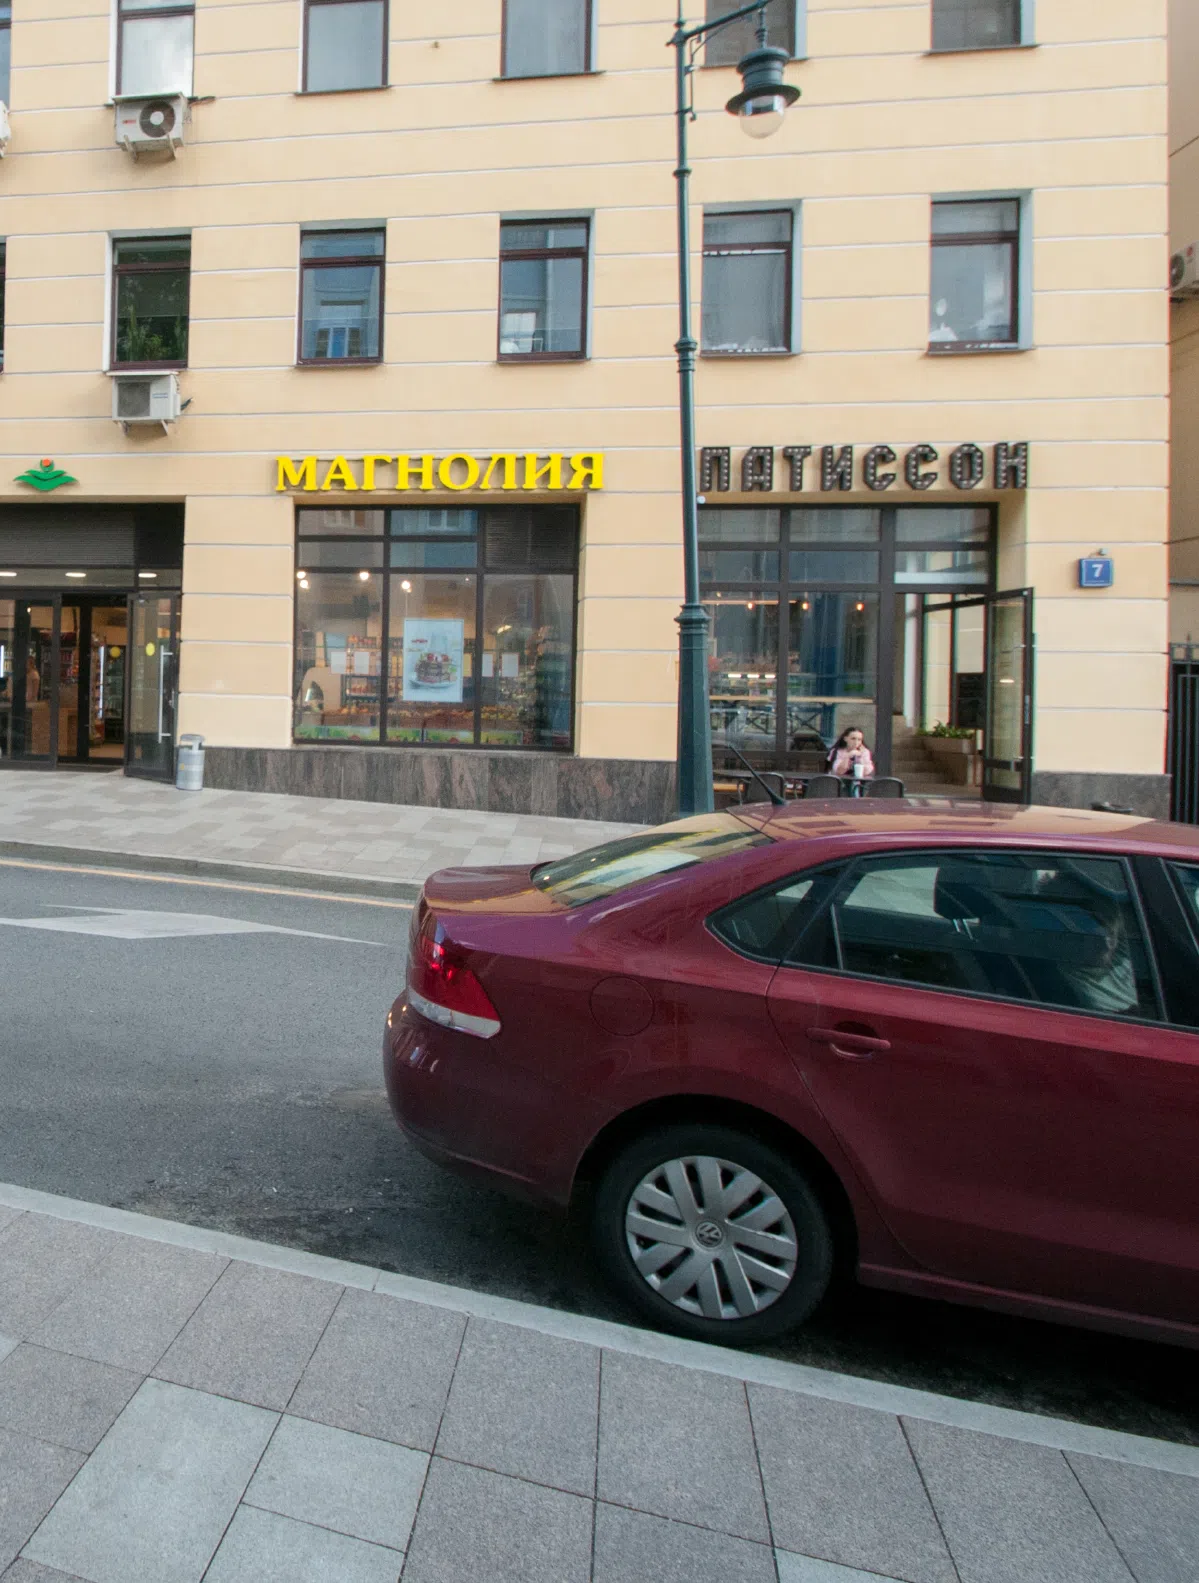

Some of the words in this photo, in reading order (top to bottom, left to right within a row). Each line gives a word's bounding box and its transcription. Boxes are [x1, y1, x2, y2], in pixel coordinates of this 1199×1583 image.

[275, 453, 605, 491] МАГНОЛИЯ
[700, 442, 1029, 492] ПАТИССОН
[1091, 563, 1104, 578] 7
